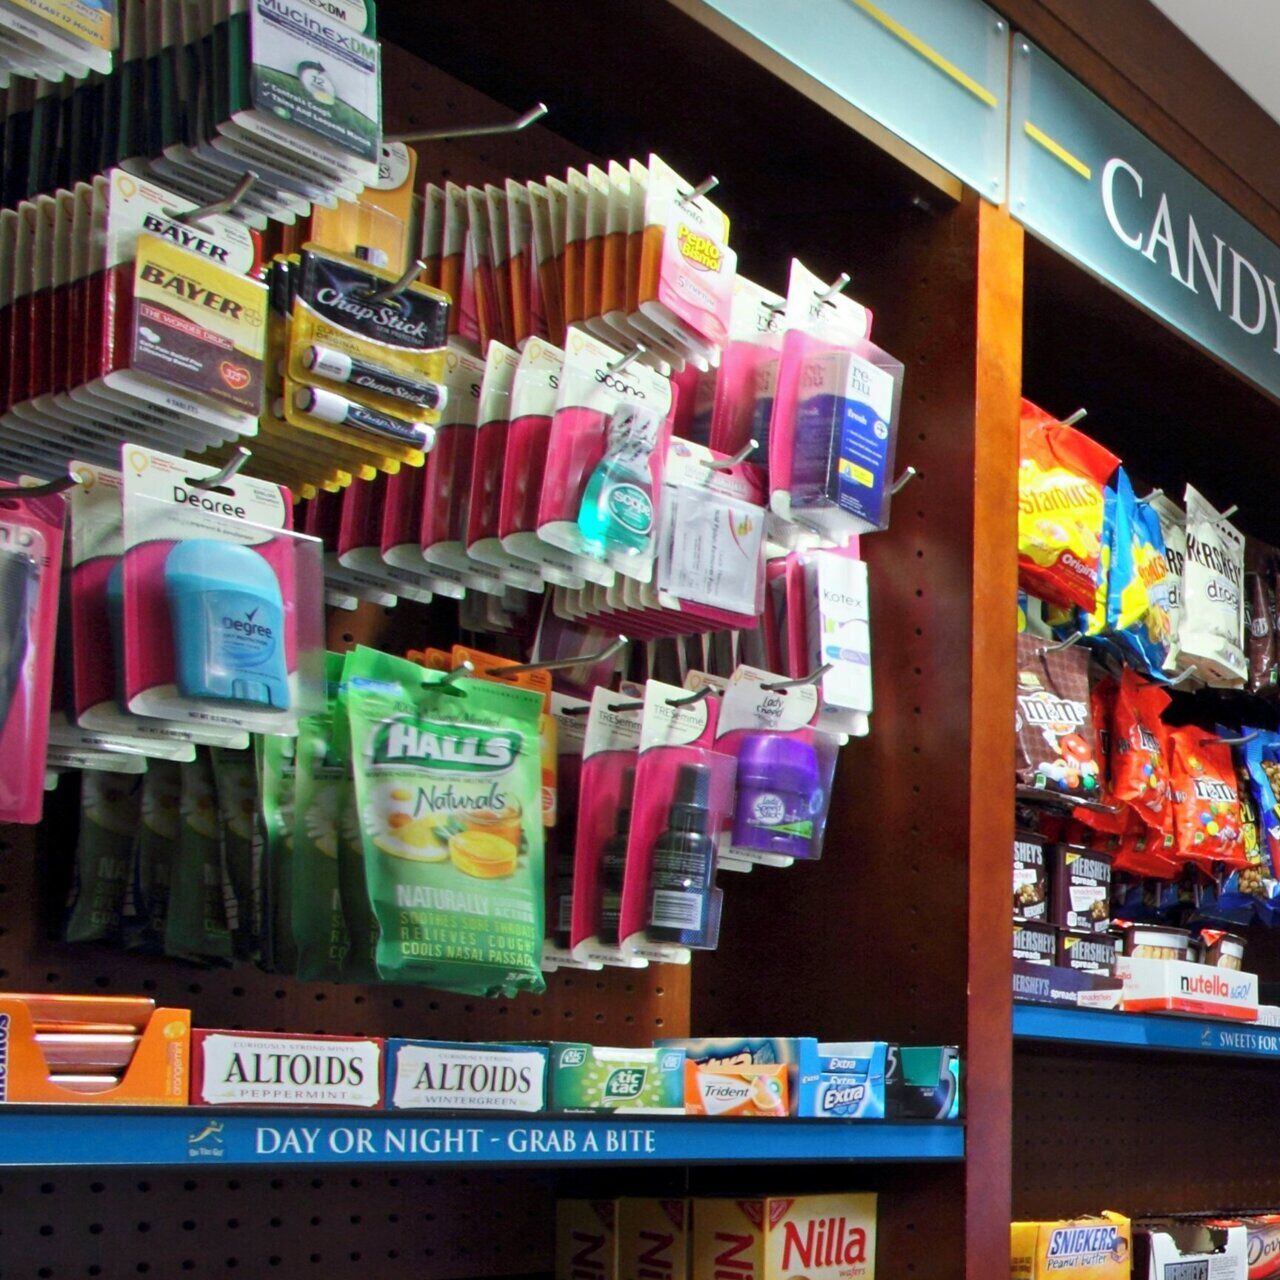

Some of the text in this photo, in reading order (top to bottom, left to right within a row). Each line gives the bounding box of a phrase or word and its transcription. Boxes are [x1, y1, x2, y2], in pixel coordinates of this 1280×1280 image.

[142, 214, 229, 264] BAYER
[677, 225, 721, 260] Pepto
[681, 242, 721, 273] Bismol
[140, 263, 243, 320] BAYER
[316, 288, 428, 339] ChapStick
[355, 375, 427, 404] ChapStick
[1018, 484, 1098, 515] Starburs
[222, 615, 273, 640] Degree
[599, 711, 642, 731] TRESemm
[386, 723, 513, 766] HALLS
[414, 782, 508, 819] Naturals
[1071, 857, 1111, 883] HERSHEY'S
[1071, 875, 1098, 887] spreads
[395, 884, 490, 917] NATURALLY
[400, 926, 477, 946] RELIEVES
[1013, 930, 1056, 956] HERSHEY'S
[401, 942, 443, 958] COOLS
[1071, 939, 1117, 964] HERSHEY'S
[1071, 959, 1100, 970] spreads
[1051, 989, 1078, 1001] spreads
[1180, 975, 1229, 998] nutella
[233, 1040, 286, 1050] CURIOUSLY
[1219, 1031, 1257, 1050] SWEETS
[1259, 1034, 1278, 1051] FOR
[224, 1052, 365, 1087] ALTOIDS
[829, 1057, 857, 1070] Extra
[414, 1061, 531, 1094] ALTOIDS
[609, 1080, 642, 1094] tac
[617, 1070, 643, 1084] tic
[239, 1088, 349, 1101] PEPPERMINT
[425, 1095, 518, 1106] WINTERGREEN
[704, 1084, 750, 1099] Trident
[825, 1085, 863, 1108] Extra
[255, 1127, 656, 1155] DAY OR NIGHT GRAB A BITE
[781, 1217, 866, 1271] Nilla
[1050, 1227, 1118, 1256] SNICKERS
[1047, 1253, 1107, 1271] Peanut butter
